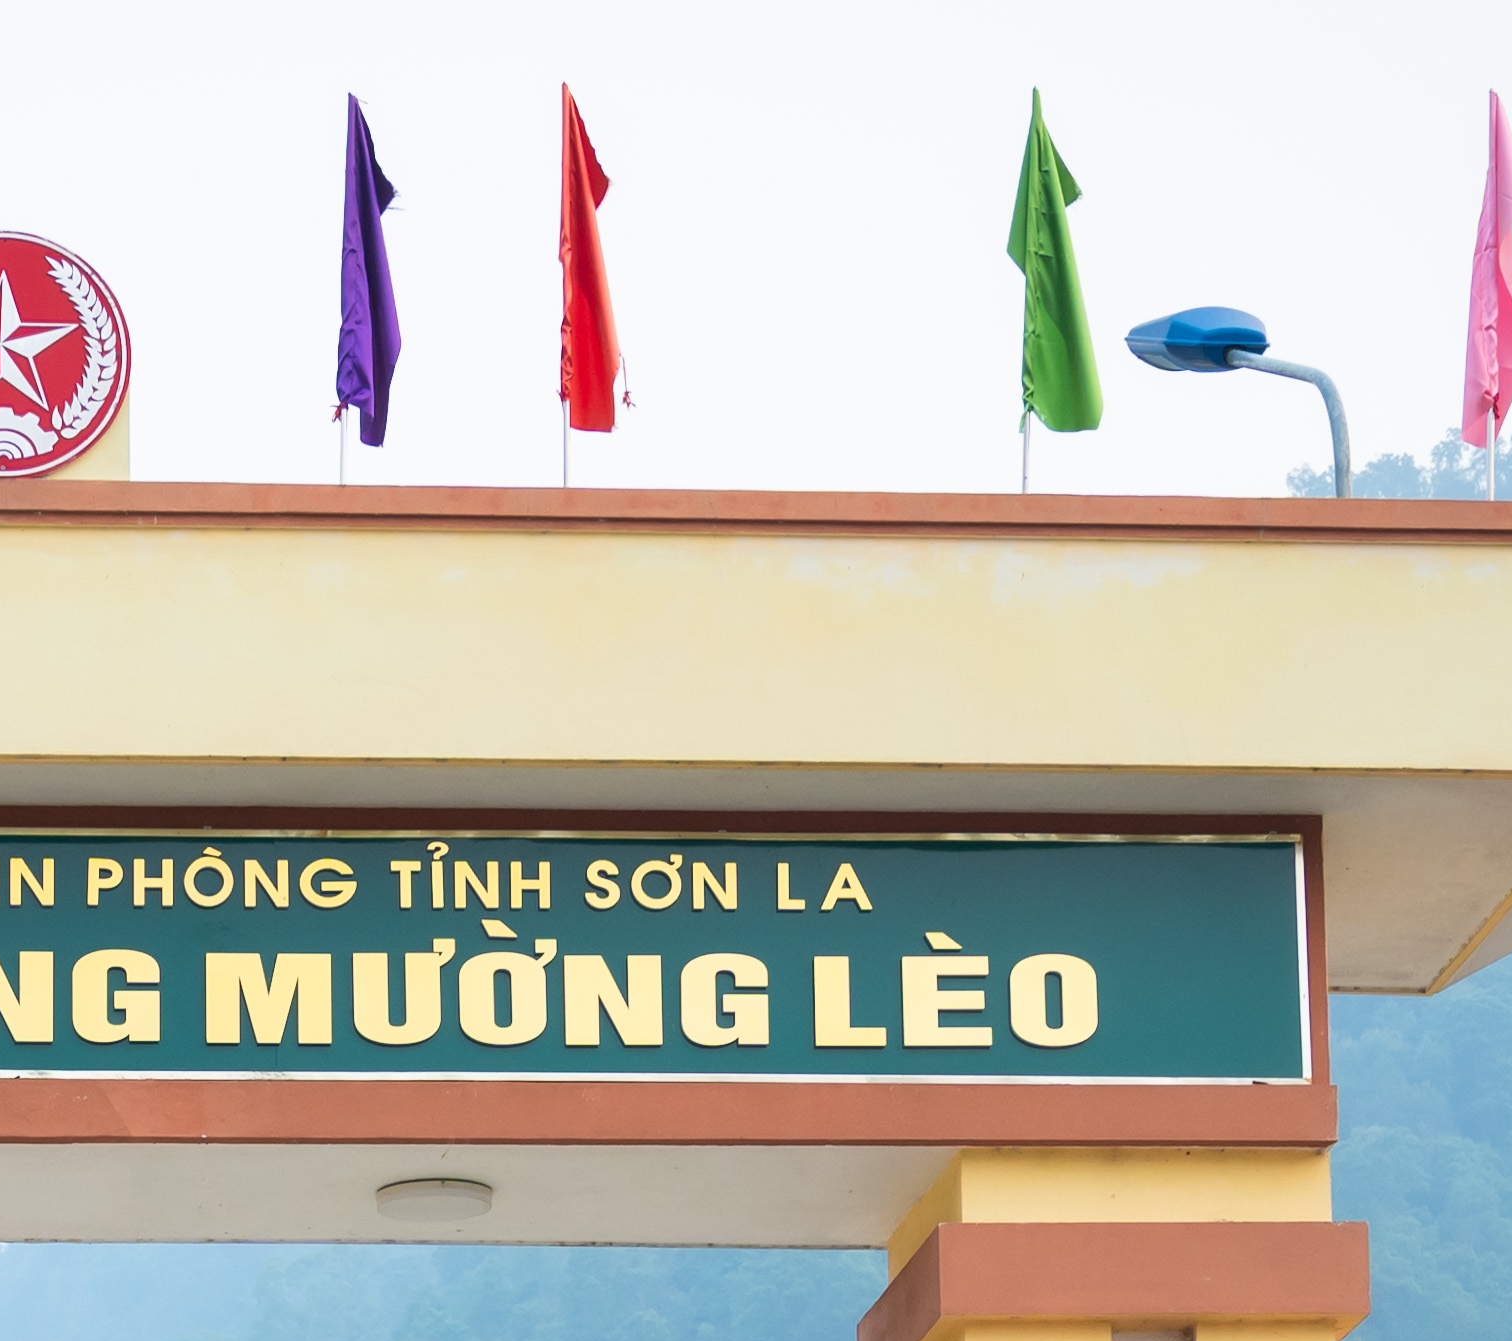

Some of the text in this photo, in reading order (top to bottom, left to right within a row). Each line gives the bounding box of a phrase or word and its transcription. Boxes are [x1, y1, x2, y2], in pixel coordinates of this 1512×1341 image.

[88, 847, 358, 908] PHÒNG
[391, 842, 551, 909] TỈNH
[585, 854, 738, 910] SƠN
[778, 863, 873, 911] LA
[206, 919, 770, 1046] MƯỜNG
[814, 932, 1099, 1047] LÈO
